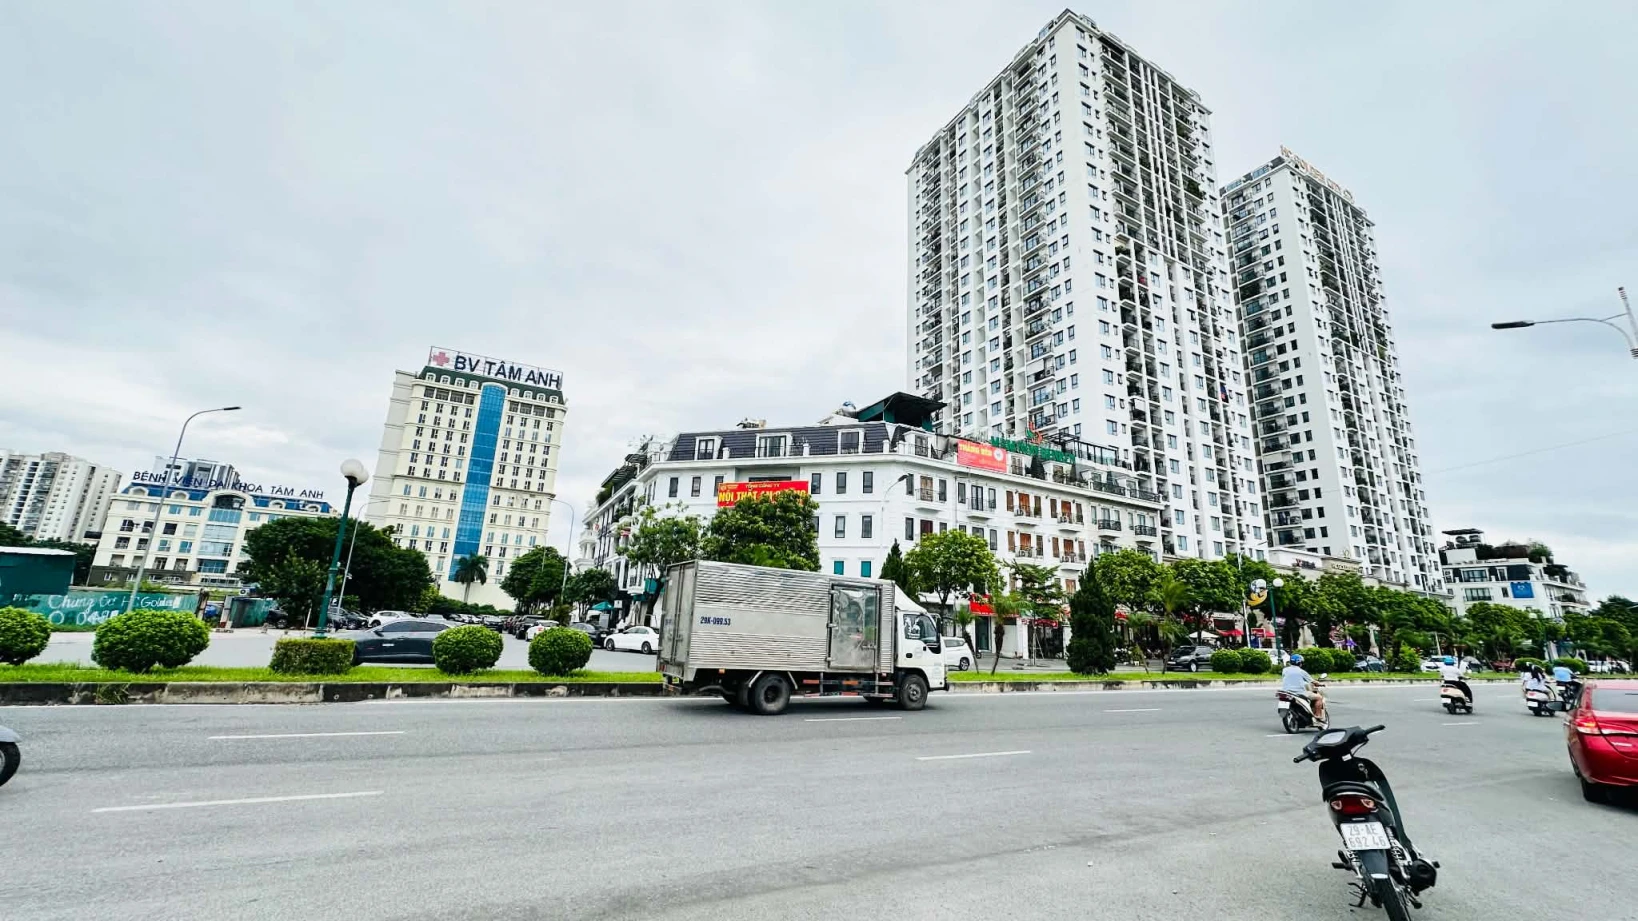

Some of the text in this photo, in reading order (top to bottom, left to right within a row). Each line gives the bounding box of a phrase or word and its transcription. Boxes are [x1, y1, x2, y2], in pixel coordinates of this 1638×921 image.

[454, 355, 561, 390] BV TÂM ANH
[231, 479, 263, 493] KHOA
[300, 486, 324, 499] ANH
